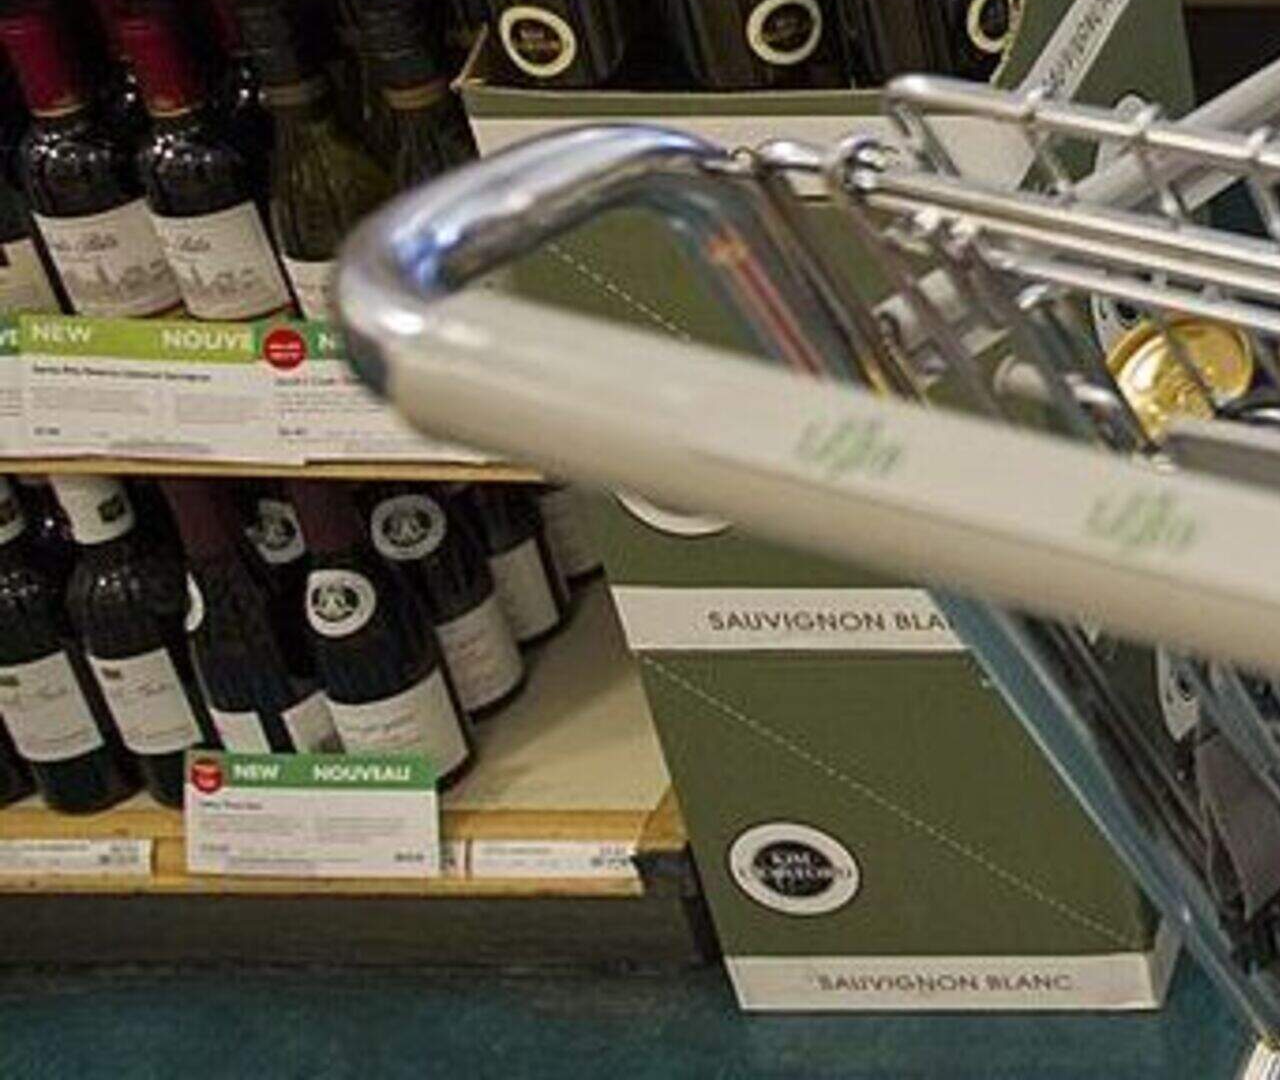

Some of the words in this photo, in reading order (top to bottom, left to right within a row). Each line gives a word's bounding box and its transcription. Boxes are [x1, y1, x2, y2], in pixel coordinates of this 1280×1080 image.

[33, 324, 92, 344] NEW
[162, 329, 254, 352] NOUVE
[707, 610, 886, 632] SAUVIGNON
[895, 610, 947, 632] BLA
[233, 762, 281, 781] NEW
[313, 763, 412, 781] NOUVEAU
[817, 973, 980, 993] SAUVIGNON
[986, 973, 1073, 993] BLANC
